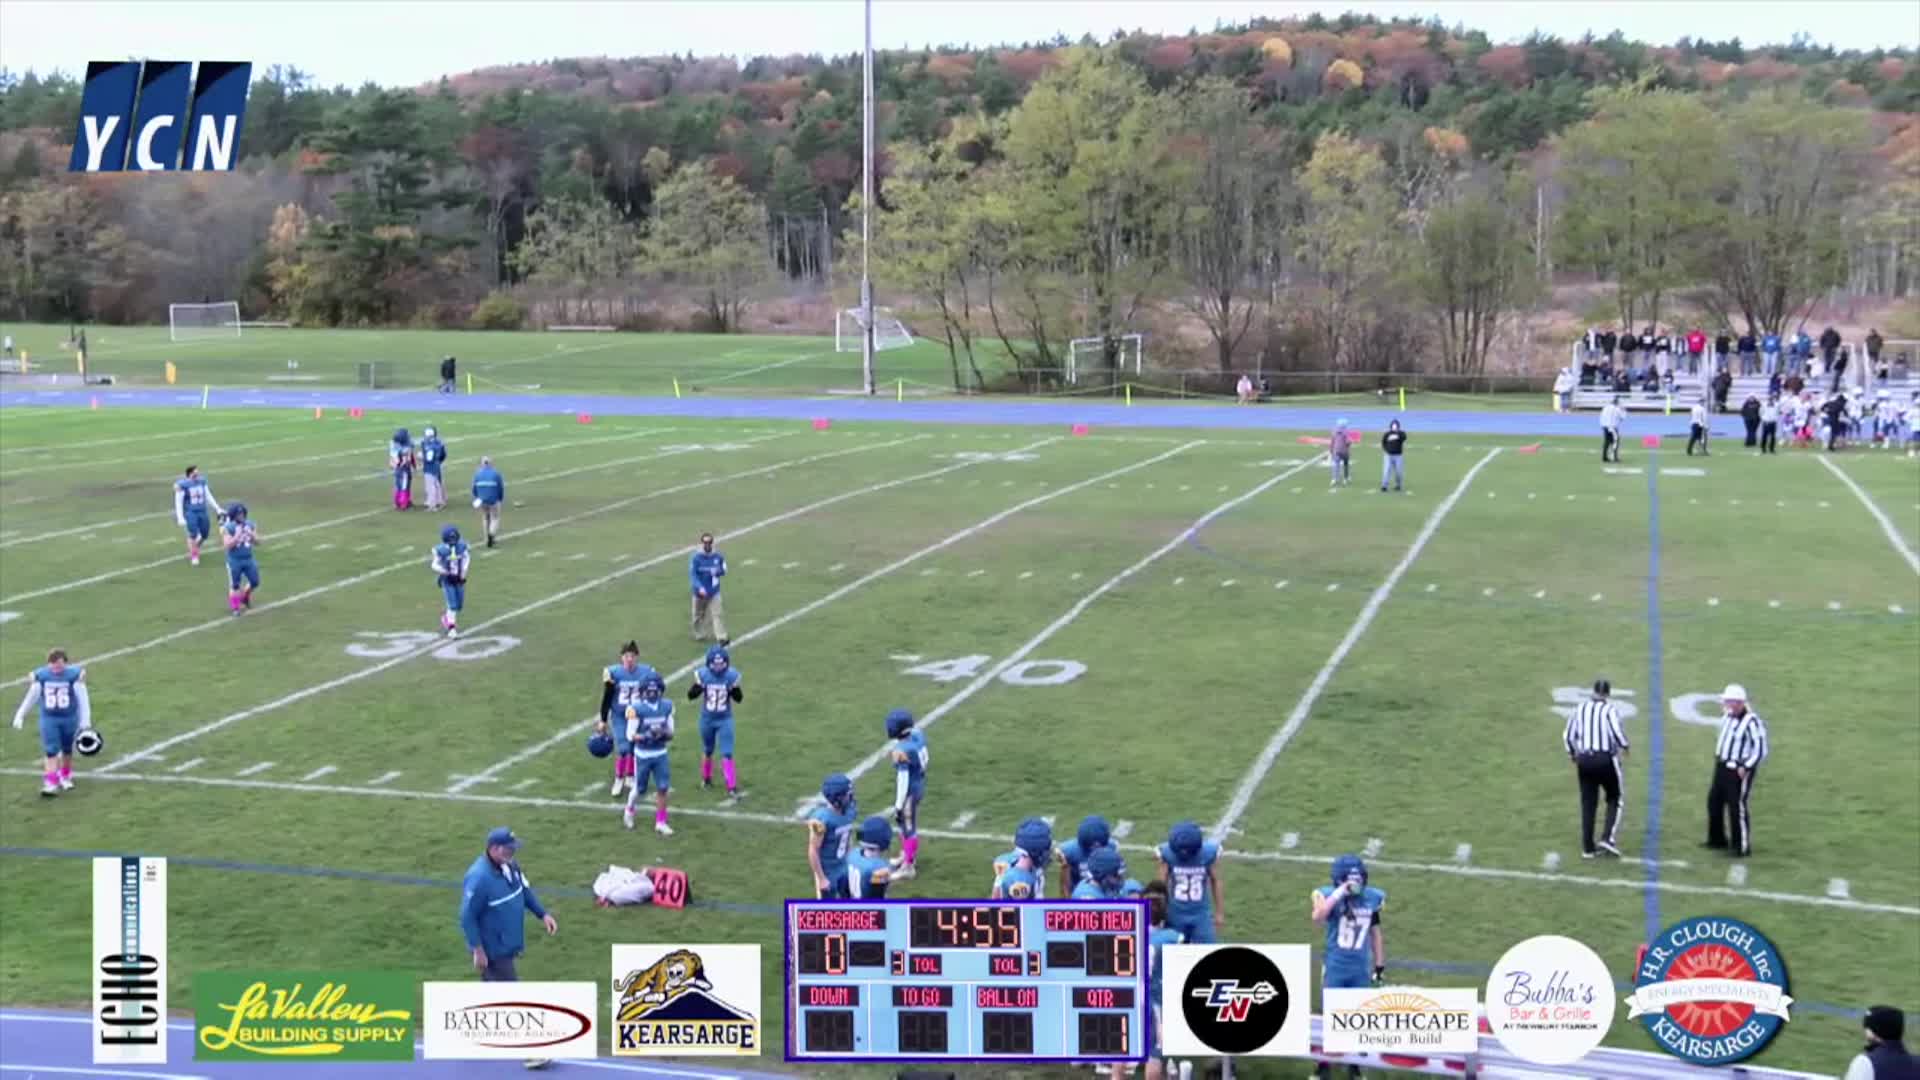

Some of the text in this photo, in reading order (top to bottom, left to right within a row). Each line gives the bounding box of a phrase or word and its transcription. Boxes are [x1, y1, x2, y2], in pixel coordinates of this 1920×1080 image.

[901, 654, 1088, 685] 40
[706, 687, 729, 711] 32
[656, 872, 683, 904] 40
